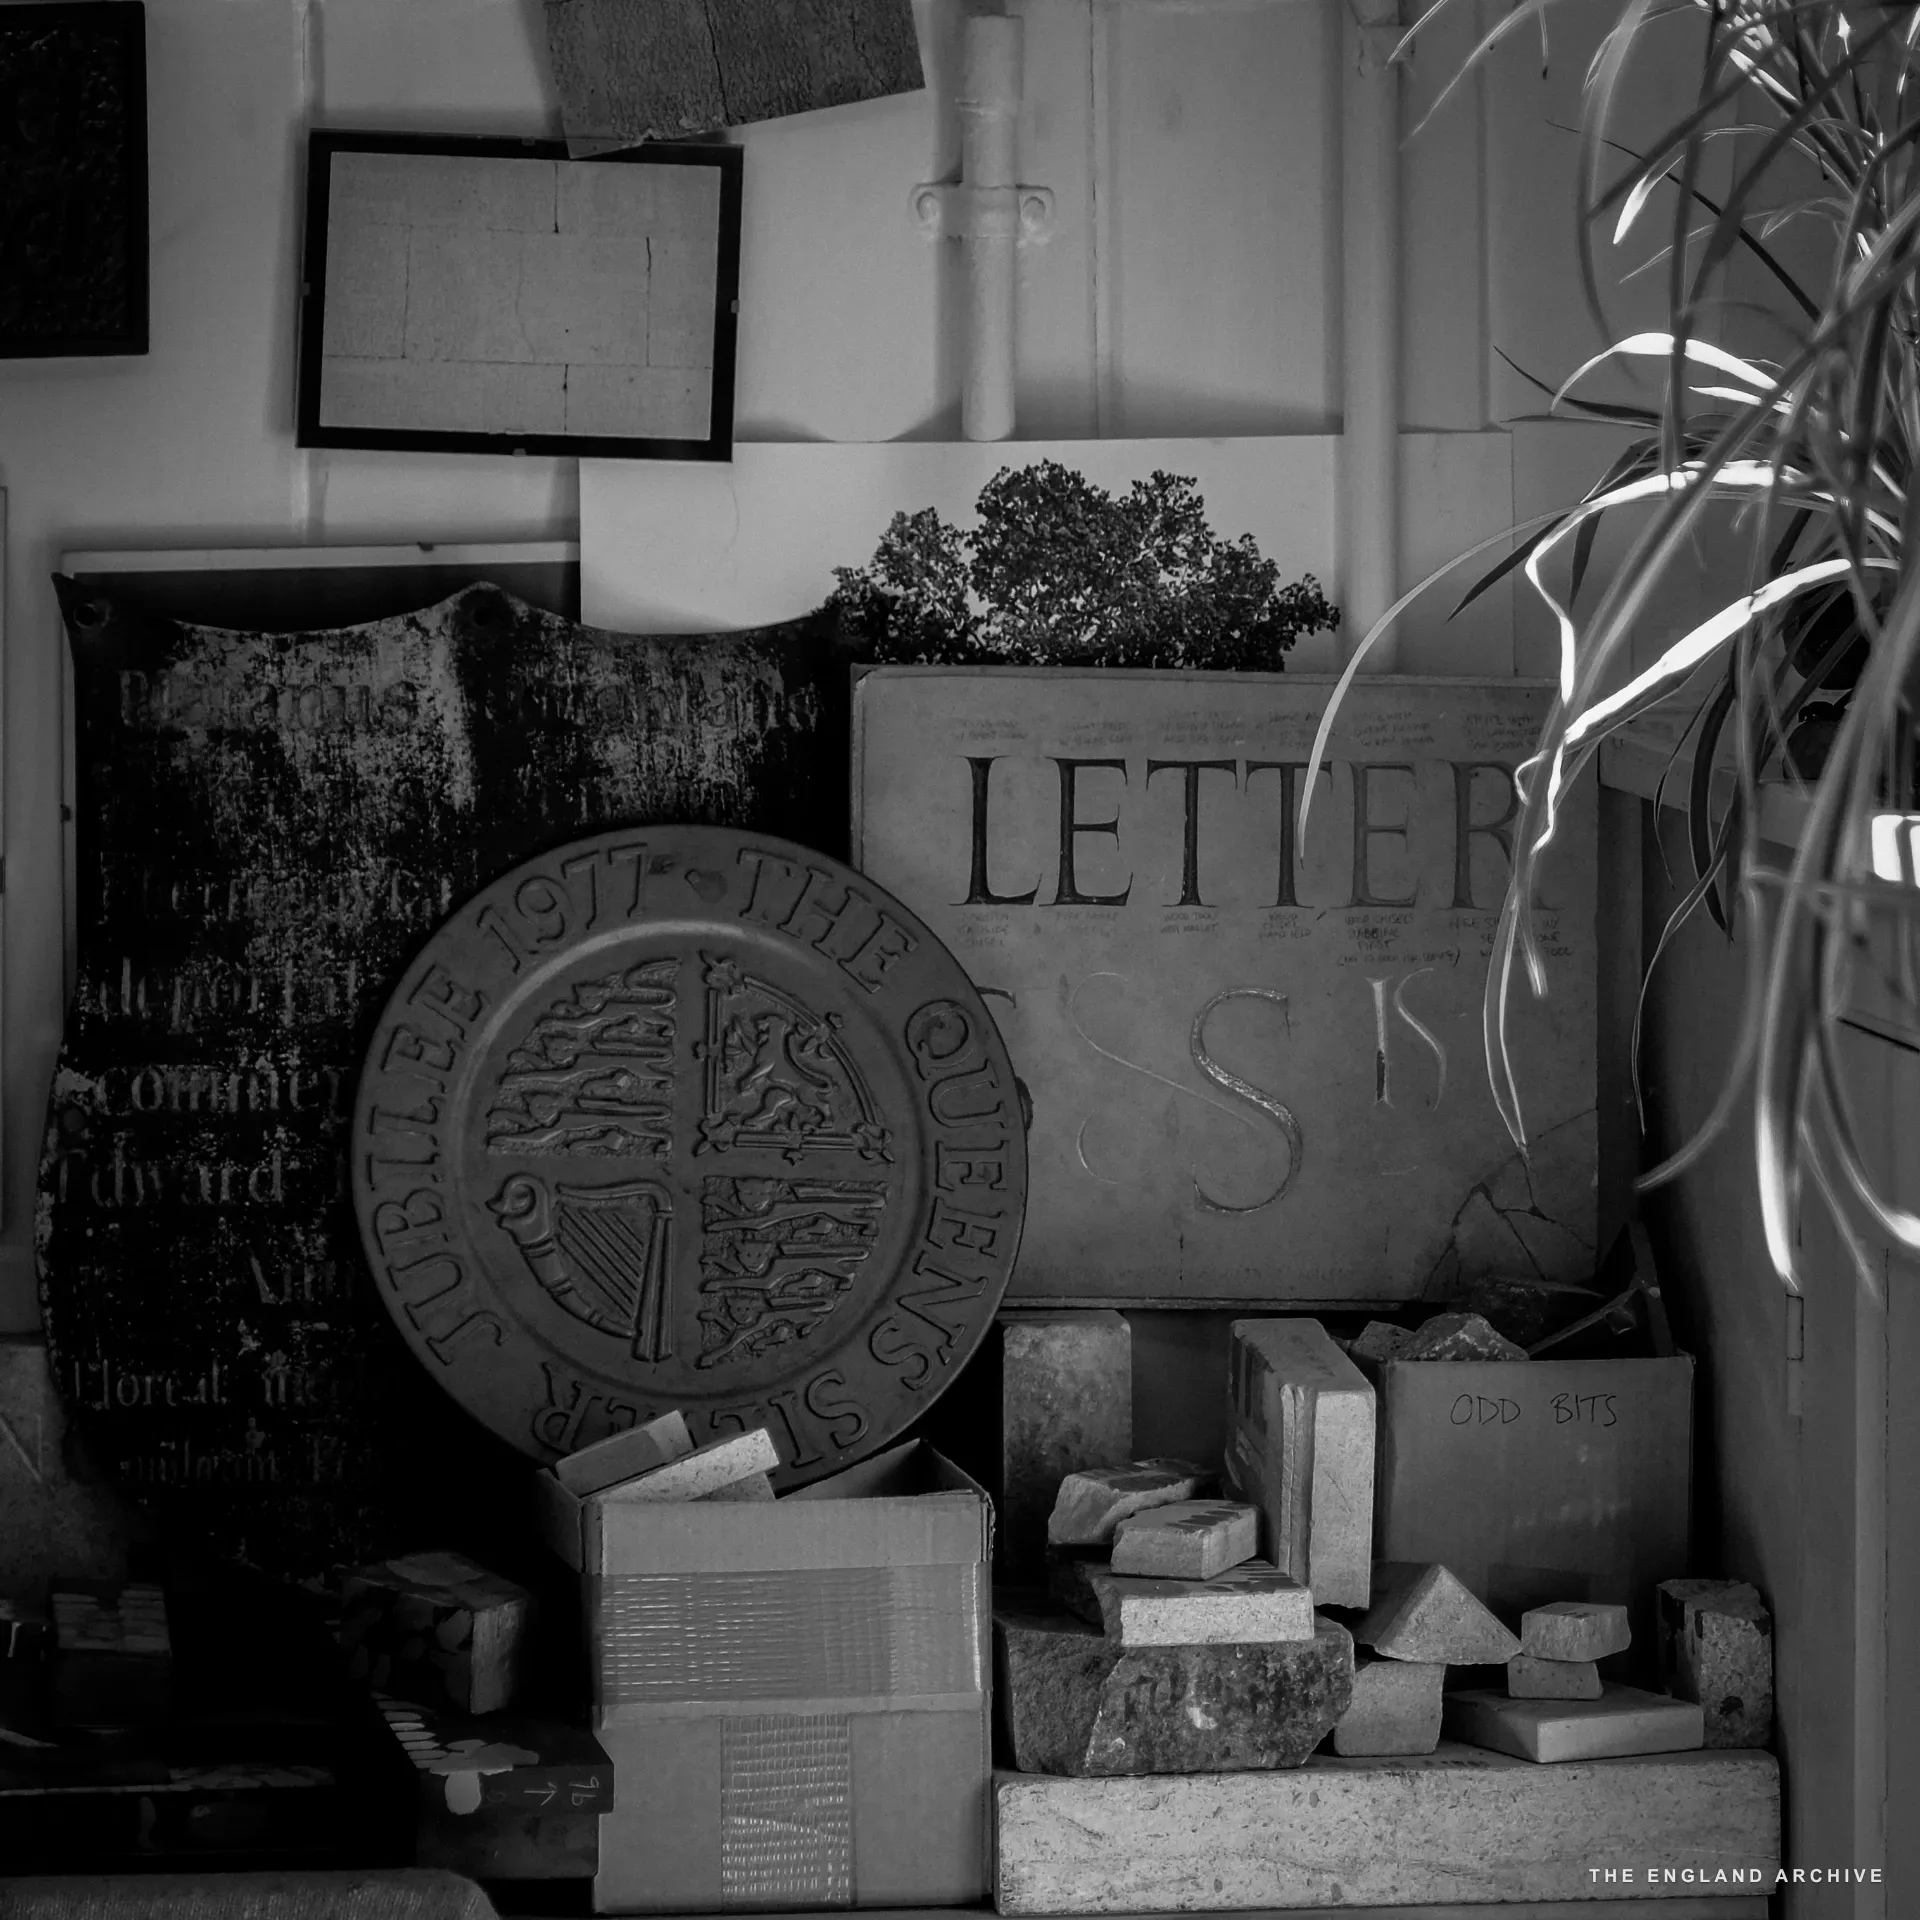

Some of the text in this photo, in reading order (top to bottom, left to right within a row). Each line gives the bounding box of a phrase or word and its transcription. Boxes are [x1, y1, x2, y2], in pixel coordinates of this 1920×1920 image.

[947, 754, 1566, 910] LETTER
[476, 842, 648, 975] 1977
[736, 847, 919, 994] THE
[365, 963, 510, 1367] JUBILEE
[532, 1361, 871, 1470] SIR
[1450, 1393, 1617, 1427] ODD BITS
